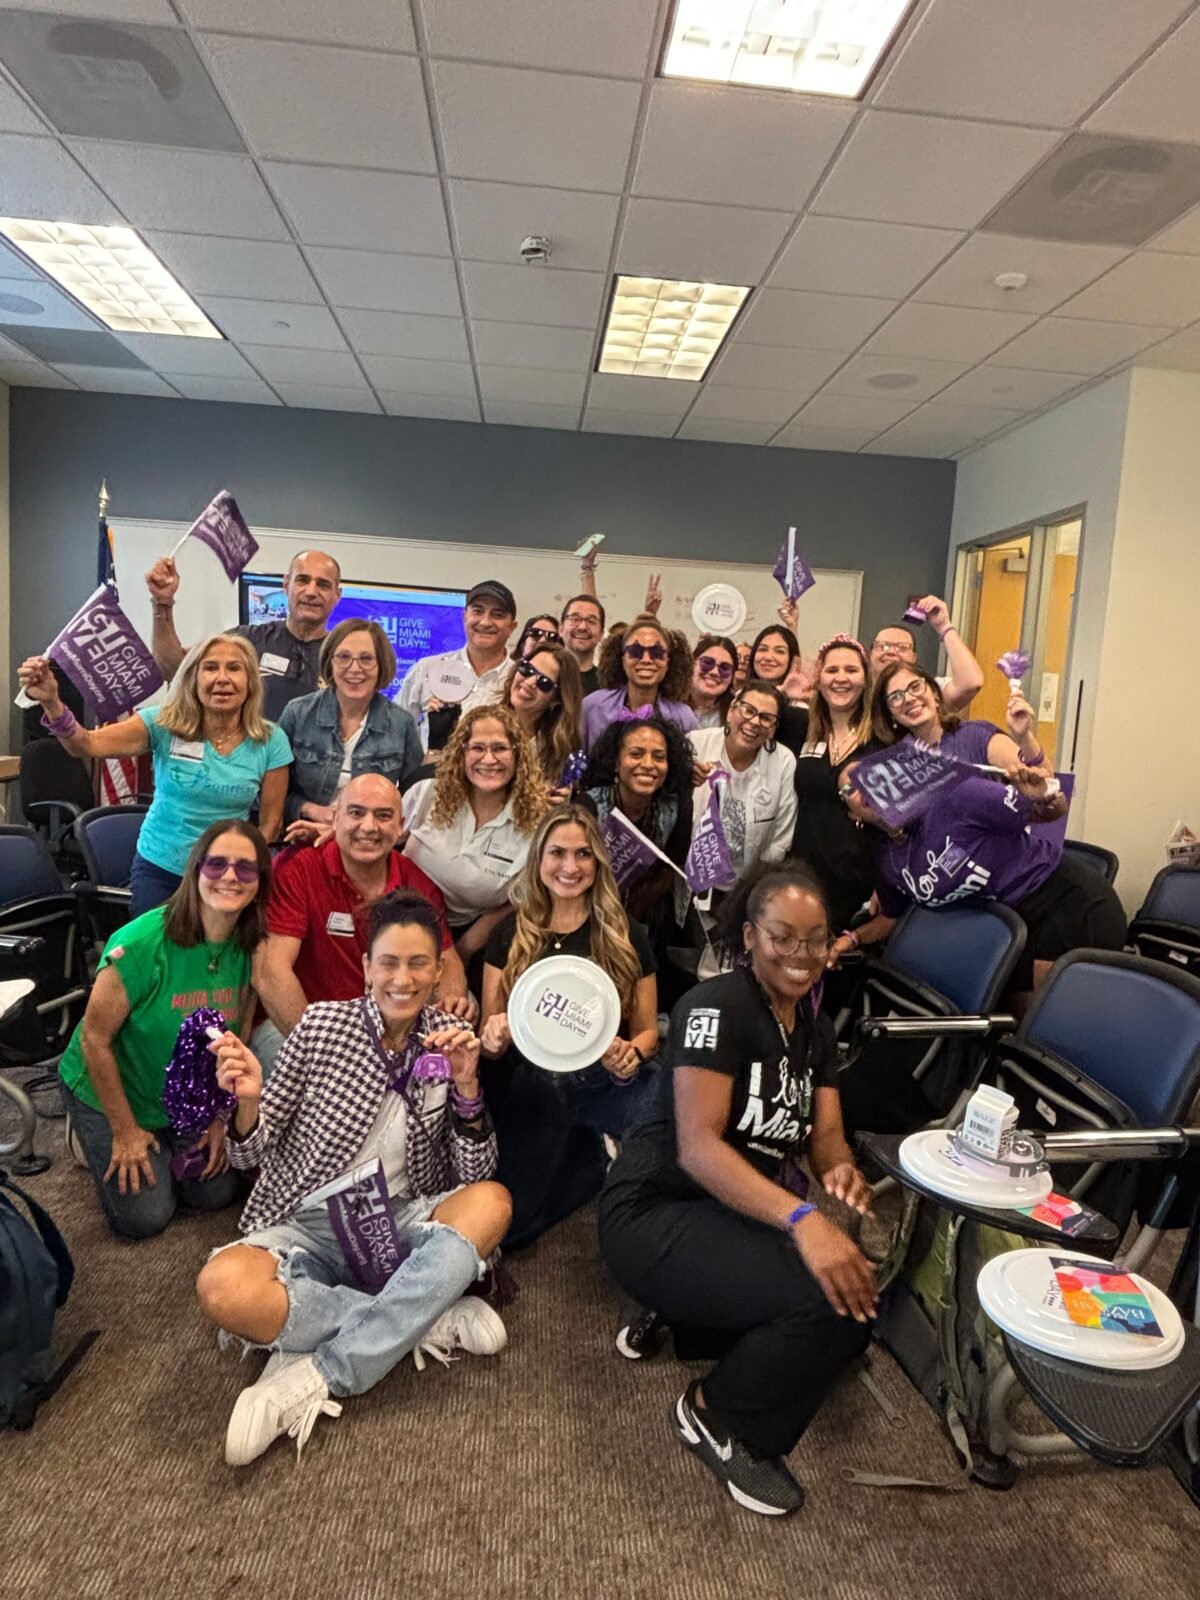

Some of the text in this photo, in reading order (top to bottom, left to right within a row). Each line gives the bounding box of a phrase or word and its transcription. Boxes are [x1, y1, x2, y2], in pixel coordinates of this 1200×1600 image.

[399, 617, 425, 629] GIVE
[399, 628, 431, 639] MIAMI
[398, 638, 420, 648] DAY
[93, 660, 121, 690] DAY
[107, 652, 144, 698] MIAMI
[121, 645, 151, 682] GIVE
[913, 760, 943, 784] DAY
[693, 841, 705, 869] DAY
[699, 836, 717, 880] MIAMI
[708, 833, 721, 865] GIVE
[564, 1010, 592, 1030] MIAMI
[568, 1001, 592, 1018] GIVE
[559, 1018, 579, 1033] DAY
[749, 1061, 763, 1097] I
[359, 1221, 380, 1254] DAY
[372, 1220, 394, 1274] MIAMI
[379, 1216, 398, 1260] GIVE
